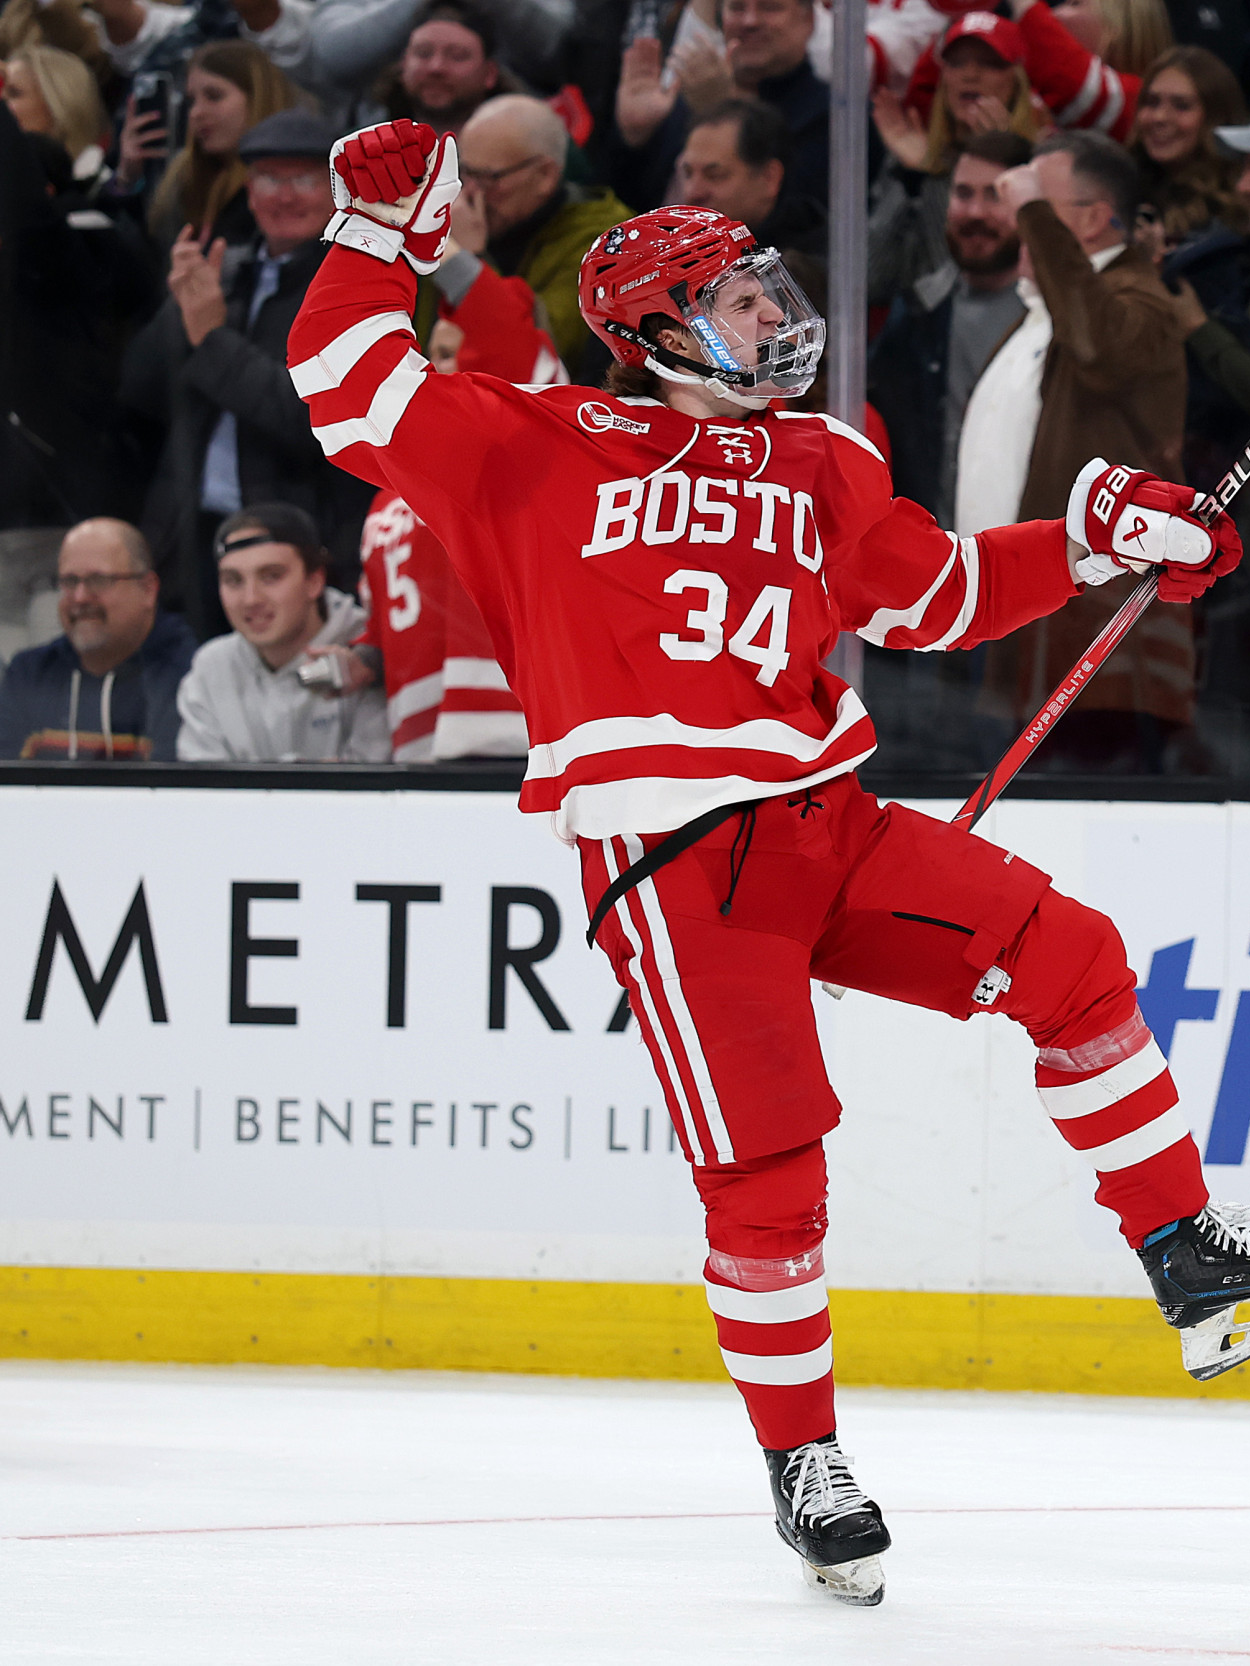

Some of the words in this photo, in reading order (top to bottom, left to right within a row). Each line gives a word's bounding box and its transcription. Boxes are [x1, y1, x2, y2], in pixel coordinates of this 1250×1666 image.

[696, 318, 738, 371] BAUER
[659, 568, 792, 688] 34
[24, 876, 630, 1033] METR
[235, 1098, 534, 1150] BENEFITS
